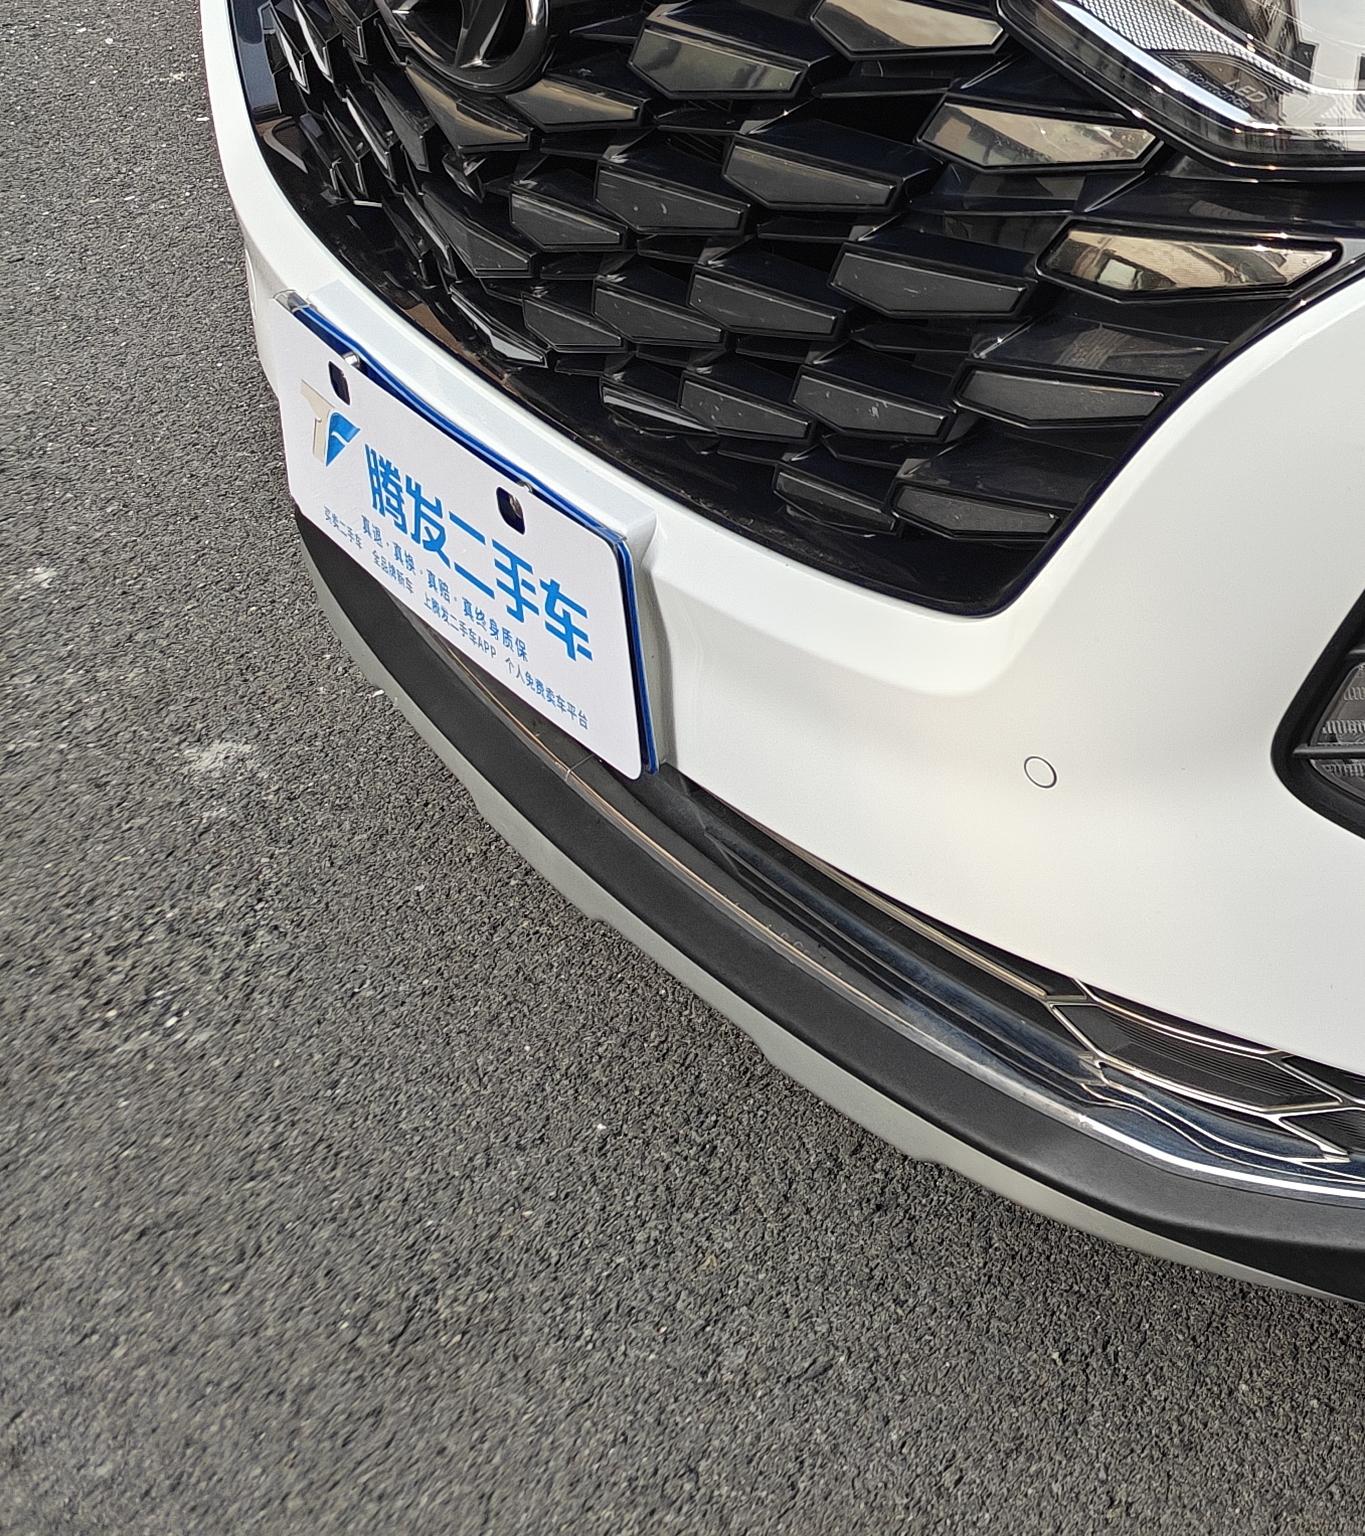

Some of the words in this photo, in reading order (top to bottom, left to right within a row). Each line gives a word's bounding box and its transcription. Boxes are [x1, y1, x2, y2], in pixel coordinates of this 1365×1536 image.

[1223, 79, 1268, 103] LED
[363, 443, 594, 664] 腾发二手车
[504, 656, 590, 731] 个人免费卖车平台
